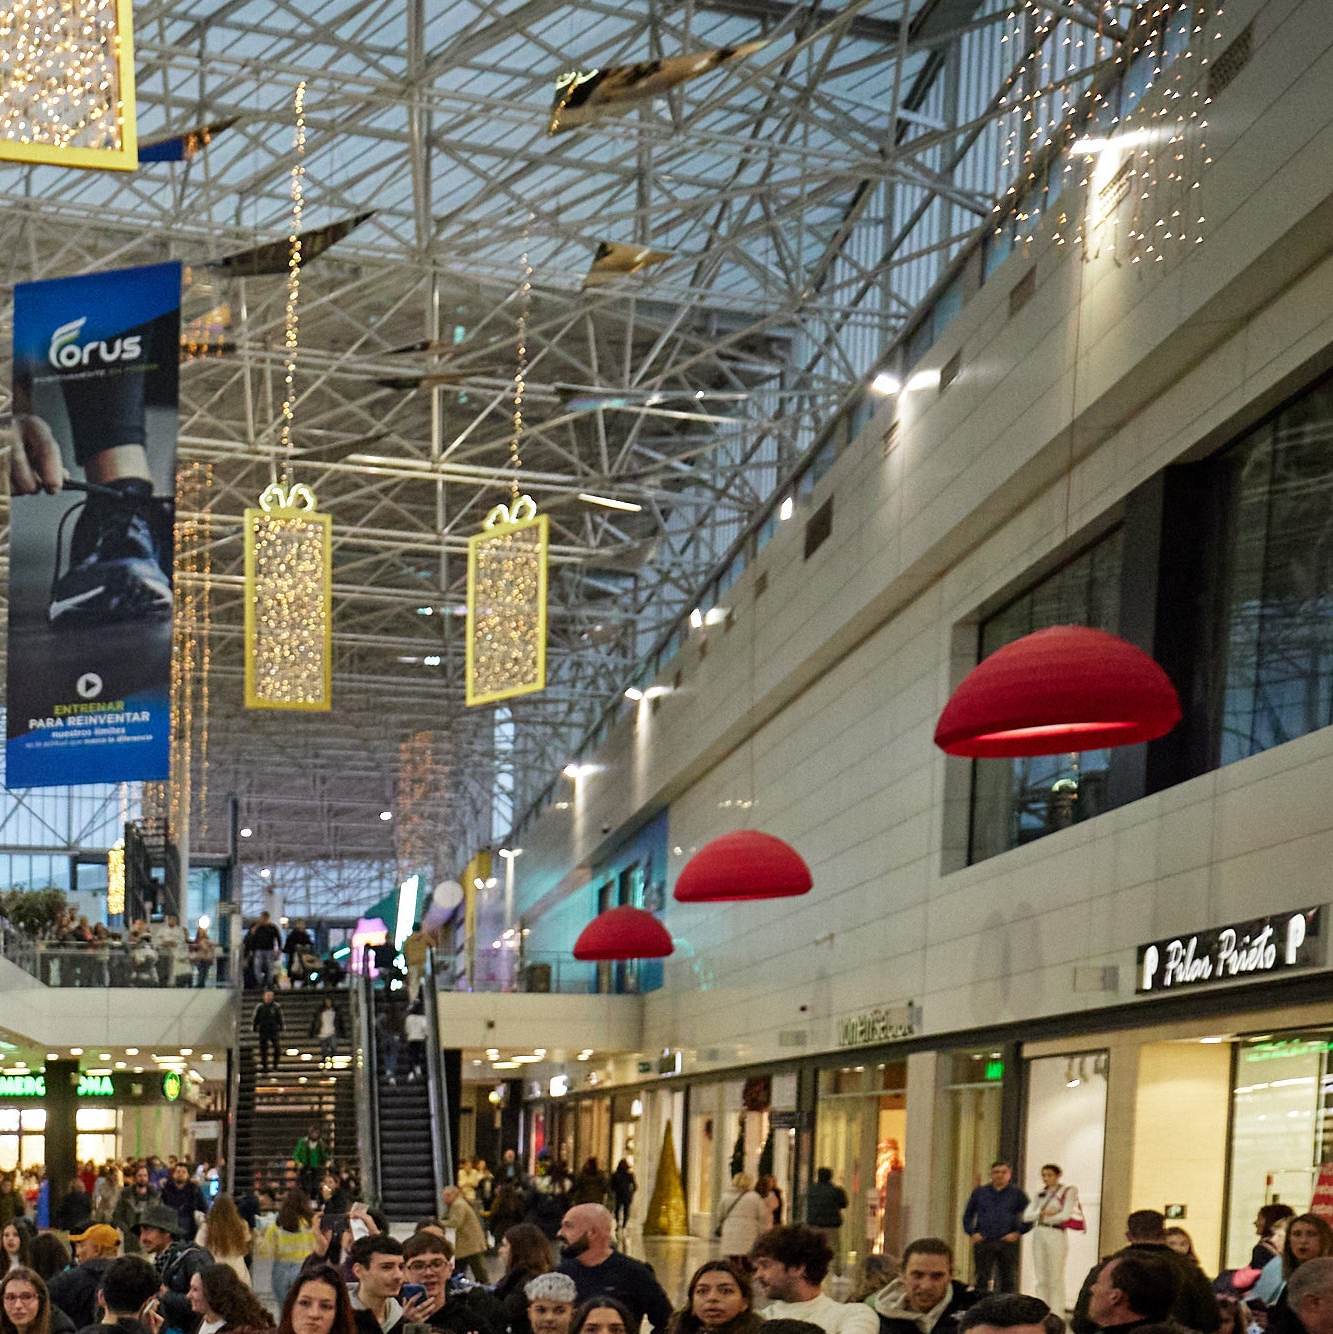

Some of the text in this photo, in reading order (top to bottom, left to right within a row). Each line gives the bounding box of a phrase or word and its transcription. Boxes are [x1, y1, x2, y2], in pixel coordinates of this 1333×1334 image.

[54, 701, 125, 715] ENTRENAR
[28, 711, 150, 729] PARA REINVENTAR
[1163, 936, 1213, 987] Pilar
[1216, 928, 1276, 977] Prieto
